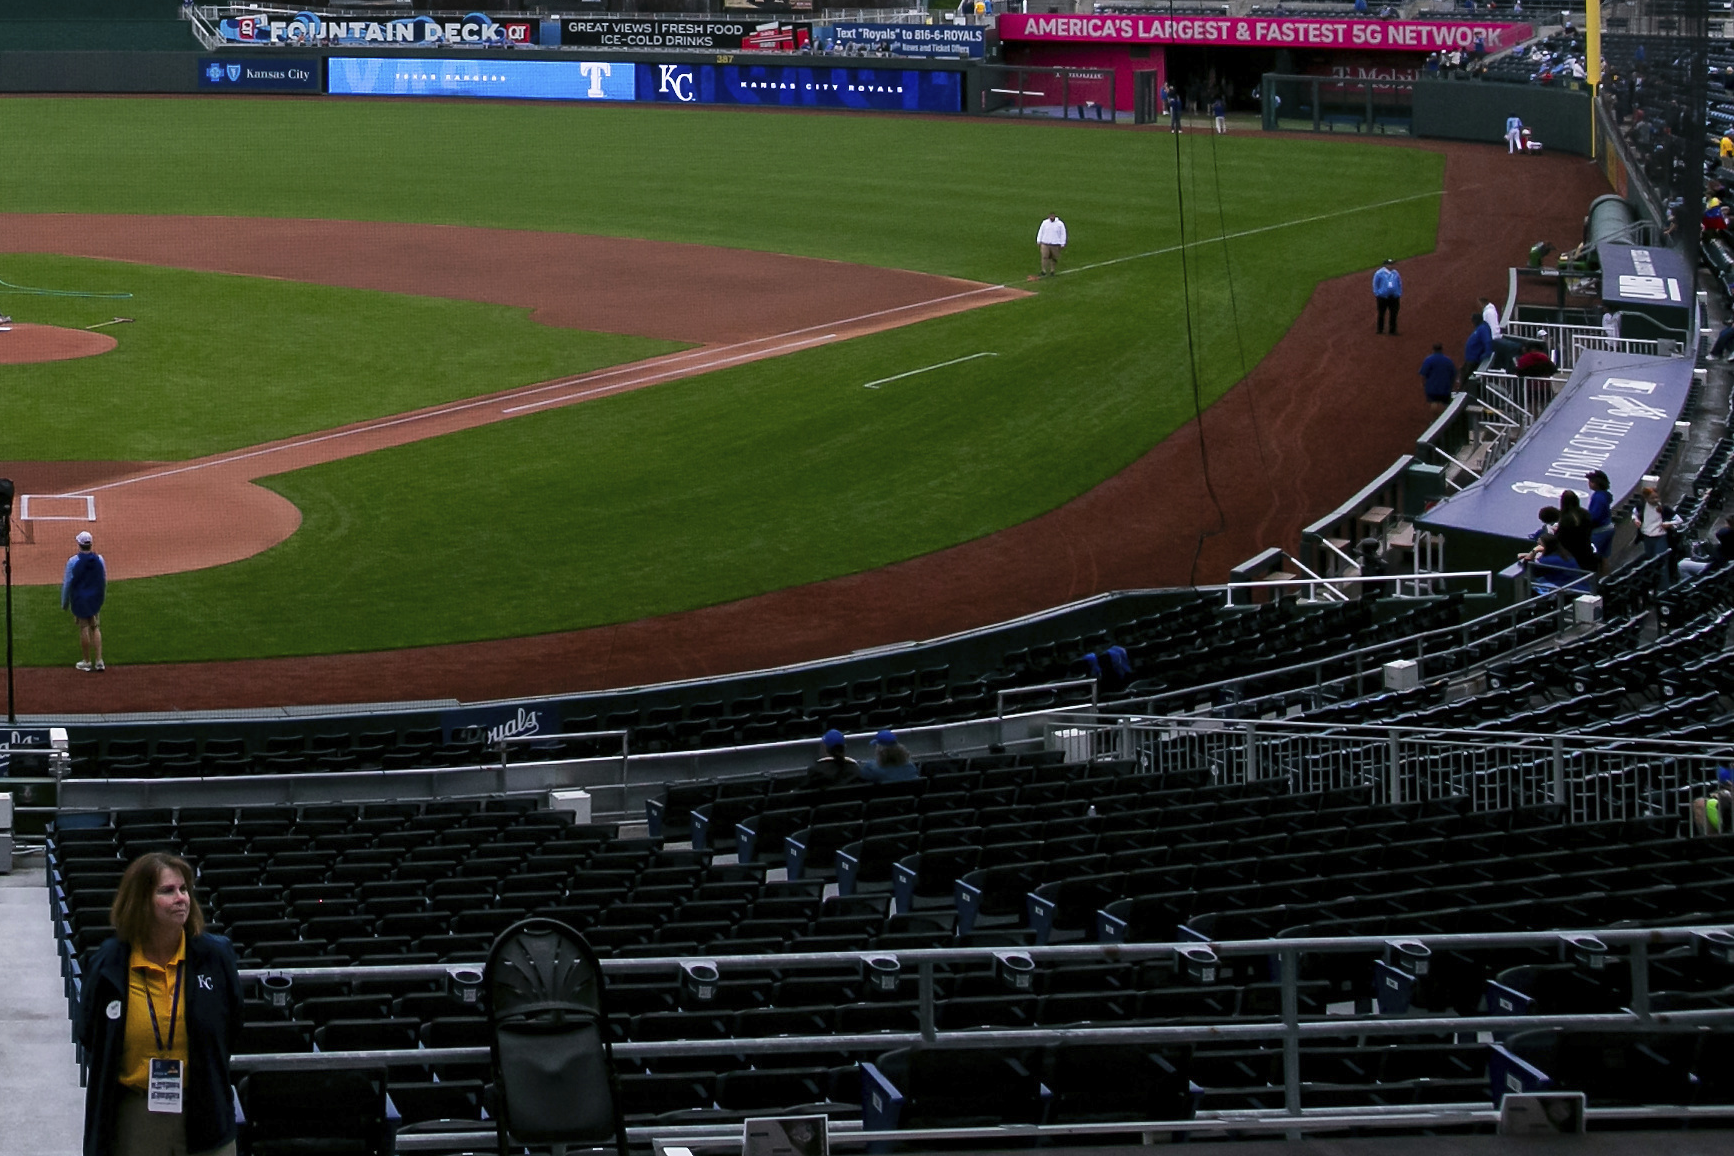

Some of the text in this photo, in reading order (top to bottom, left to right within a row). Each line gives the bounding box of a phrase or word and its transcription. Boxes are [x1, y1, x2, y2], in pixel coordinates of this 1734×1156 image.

[270, 21, 526, 43] FOUNTAIN DECK QT
[568, 22, 743, 35] GREAT VIEWS FRESH FOOD
[836, 28, 856, 39] Text
[902, 29, 913, 40] to
[914, 29, 982, 42] 816-6-ROYALS
[1024, 17, 1503, 47] AMERICA'S LARGEST & FASTEST 5G NETWORK
[601, 34, 713, 47] ICE-COLD DRINKS
[903, 44, 919, 52] News
[919, 44, 932, 52] and
[932, 44, 951, 53] Ticket
[951, 45, 970, 53] Offers
[716, 55, 734, 64] 387
[246, 67, 311, 82] Kansas City
[659, 65, 696, 102] KC
[740, 81, 904, 93] KANSAS CITY ROYALS
[197, 975, 214, 990] KC
